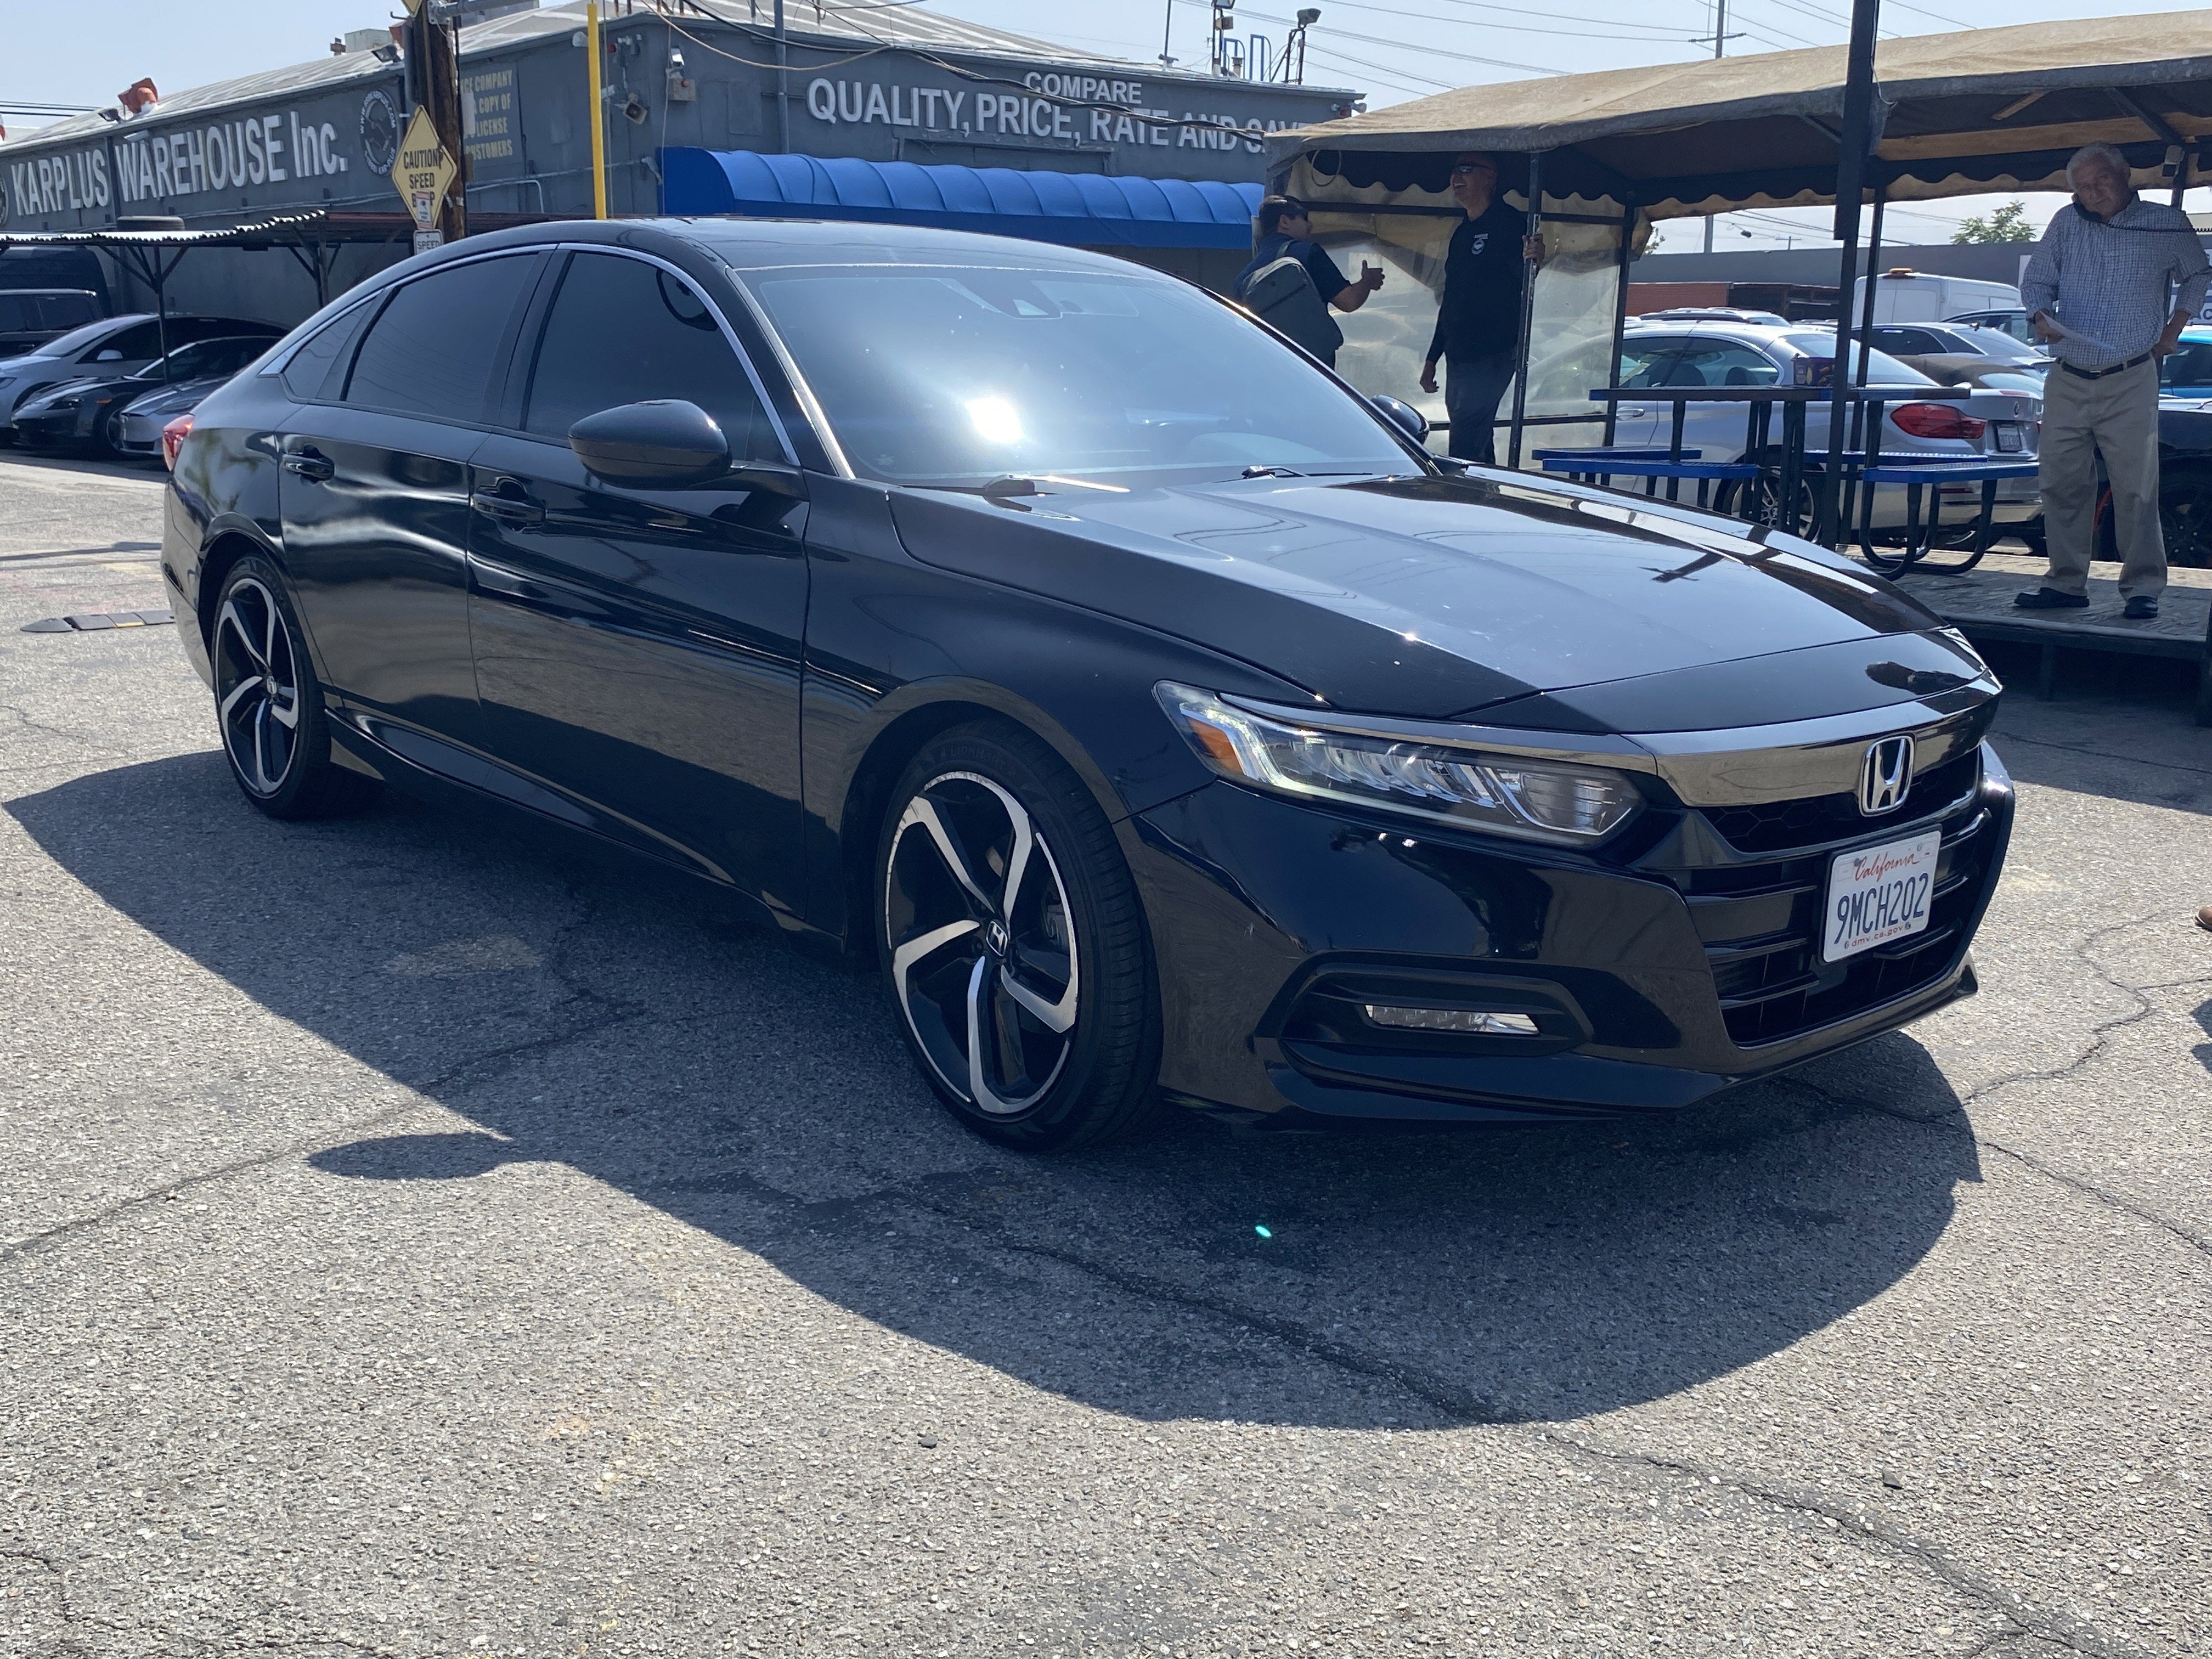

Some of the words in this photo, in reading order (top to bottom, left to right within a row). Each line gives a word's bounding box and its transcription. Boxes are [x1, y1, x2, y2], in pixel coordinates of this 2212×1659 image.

[475, 70, 512, 92] COMPANY
[1024, 71, 1142, 104] COMPARE
[479, 95, 499, 114] COPY
[501, 93, 511, 110] OF
[807, 78, 969, 138] QUALITY,
[975, 93, 1081, 147] PRICE,
[1090, 107, 1169, 145] RATE
[1177, 112, 1238, 150] AND
[476, 116, 508, 137] LICENSE
[11, 149, 108, 216] KARPLUS
[115, 115, 288, 202] WAREHOUSE
[290, 111, 348, 178] Inc.
[404, 149, 439, 169] CAUTION
[409, 173, 435, 189] SPEED
[412, 191, 435, 207] BP
[417, 240, 439, 250] SPEED
[1855, 851, 1920, 882] California
[1834, 872, 1929, 945] 9MCH202
[1852, 926, 1903, 947] dmv.ca.gov
